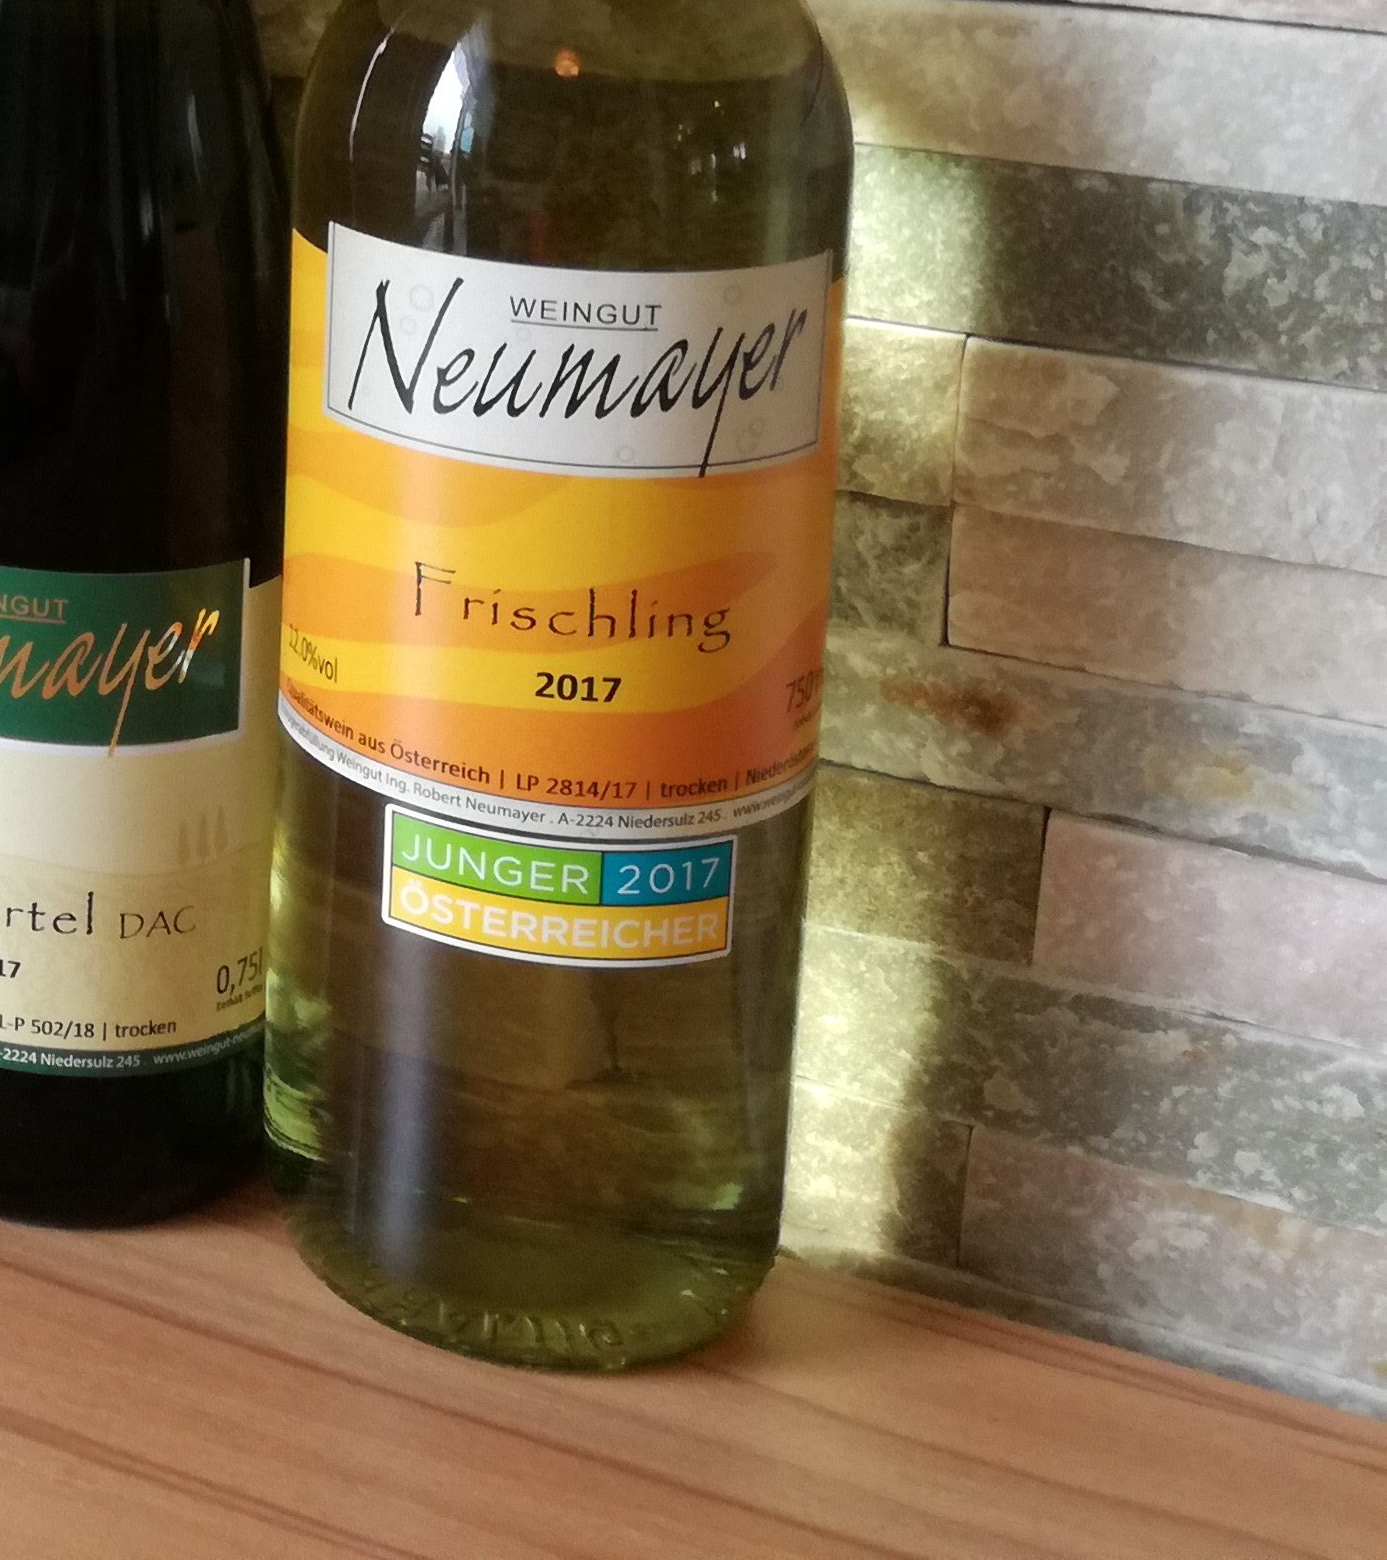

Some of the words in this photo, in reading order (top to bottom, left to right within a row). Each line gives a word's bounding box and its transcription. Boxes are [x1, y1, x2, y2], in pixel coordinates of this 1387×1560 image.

[508, 294, 663, 329] WEINGUT
[348, 276, 807, 478] Neumayer
[412, 560, 732, 653] Frischling
[534, 671, 623, 704] 2017
[337, 752, 384, 783] Weingut
[385, 772, 410, 794] Ing.
[413, 781, 462, 808] Robert
[465, 795, 546, 824] Neumayer
[557, 811, 614, 829] A-2224
[618, 812, 695, 831] Niedersulz
[697, 808, 722, 825] 245
[358, 731, 386, 754] aus
[390, 738, 491, 785] Österreich
[516, 772, 539, 790] LP
[545, 776, 637, 801] 2814/17
[660, 775, 728, 798] trocken
[401, 832, 590, 896] JUNGER
[617, 856, 721, 897] 2017
[119, 905, 197, 940] DAC
[399, 878, 720, 951] ÖSTERREICHER
[216, 946, 264, 996] 0,75l
[30, 1017, 95, 1041] 502/18
[114, 1019, 177, 1039] trocken
[40, 1050, 114, 1069] Niedersulz
[115, 1055, 141, 1069] 245
